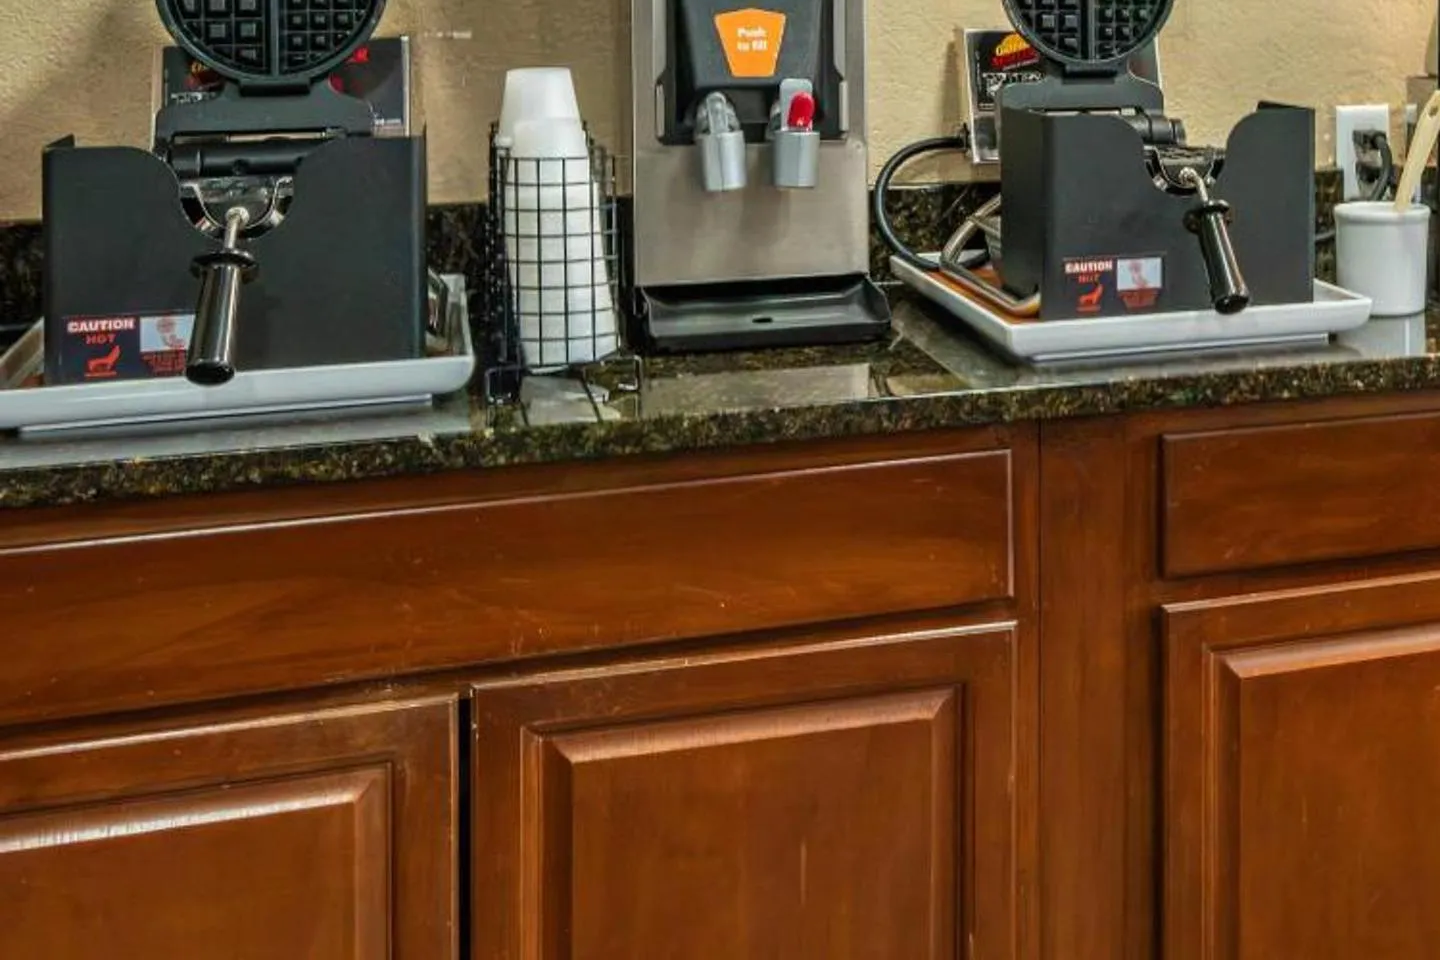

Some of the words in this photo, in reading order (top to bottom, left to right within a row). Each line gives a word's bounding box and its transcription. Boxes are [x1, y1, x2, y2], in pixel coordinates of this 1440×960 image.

[1064, 259, 1113, 274] CAUTION
[66, 318, 135, 334] CAUTION
[86, 333, 117, 345] HOT
